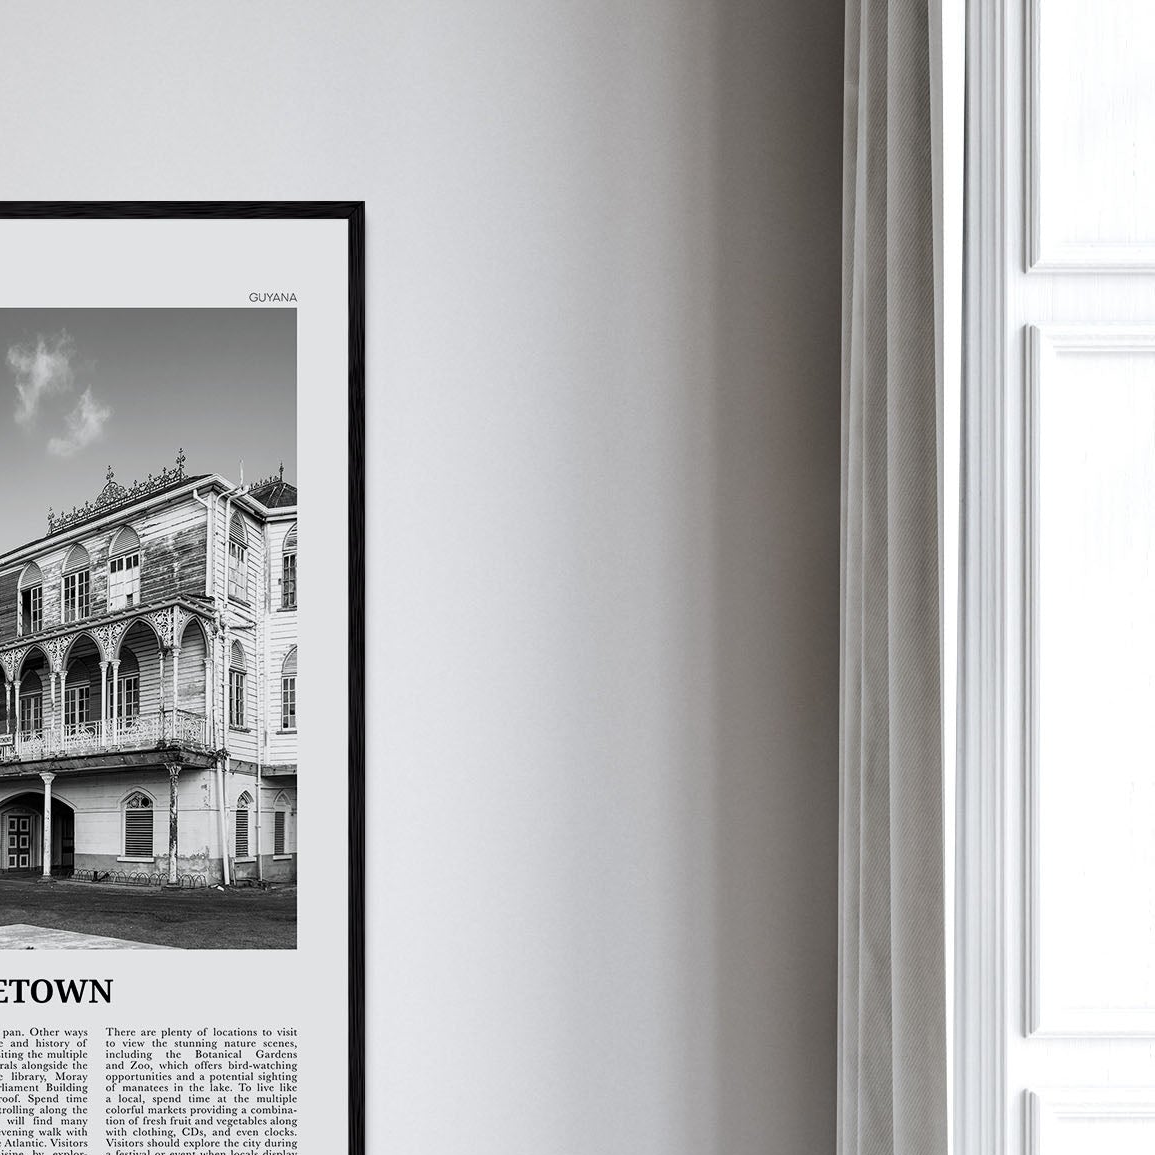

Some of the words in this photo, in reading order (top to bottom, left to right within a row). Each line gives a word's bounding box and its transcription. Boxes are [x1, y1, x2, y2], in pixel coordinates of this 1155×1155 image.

[249, 293, 298, 302] GUYANA
[3, 1030, 24, 1039] pan.
[29, 1027, 59, 1037] Other
[64, 1030, 88, 1039] ways
[105, 1027, 136, 1037] There
[161, 1027, 192, 1039] plenty
[197, 1027, 208, 1037] of
[213, 1027, 257, 1037] locations
[263, 1029, 272, 1037] to
[277, 1027, 297, 1037] visit
[10, 1038, 29, 1048] and
[36, 1038, 70, 1050] history
[77, 1038, 88, 1048] of
[106, 1040, 115, 1048] to
[122, 1038, 145, 1048] view
[152, 1038, 167, 1048] the
[174, 1038, 217, 1050] stunning
[224, 1040, 256, 1048] nature
[263, 1041, 297, 1049] scenes,
[27, 1049, 43, 1059] the
[47, 1049, 87, 1061] multiple
[105, 1061, 124, 1070] and
[130, 1061, 153, 1071] Zoo,
[159, 1061, 188, 1070] which
[195, 1061, 223, 1070] offers
[229, 1061, 297, 1072] bird-watching
[105, 1083, 117, 1092] of
[123, 1084, 169, 1092] manatees
[174, 1083, 183, 1092] in
[189, 1083, 205, 1092] the
[210, 1083, 233, 1092] lake.
[238, 1083, 251, 1092] To
[257, 1083, 274, 1092] live
[280, 1083, 297, 1092] like
[28, 1094, 59, 1106] Spend
[66, 1094, 88, 1103] time
[39, 1105, 67, 1117] along
[73, 1105, 87, 1115] the
[106, 1116, 125, 1126] tion
[128, 1116, 139, 1126] of
[143, 1116, 167, 1126] fresh
[170, 1116, 191, 1126] fruit
[195, 1116, 213, 1126] and
[216, 1116, 267, 1128] vegetables
[270, 1116, 297, 1128] along
[39, 1127, 61, 1137] walk
[66, 1127, 87, 1137] with
[106, 1138, 144, 1148] Visitors
[147, 1138, 180, 1148] should
[183, 1138, 220, 1150] explore
[224, 1138, 239, 1148] the
[243, 1138, 261, 1150] city
[265, 1138, 297, 1150] during
